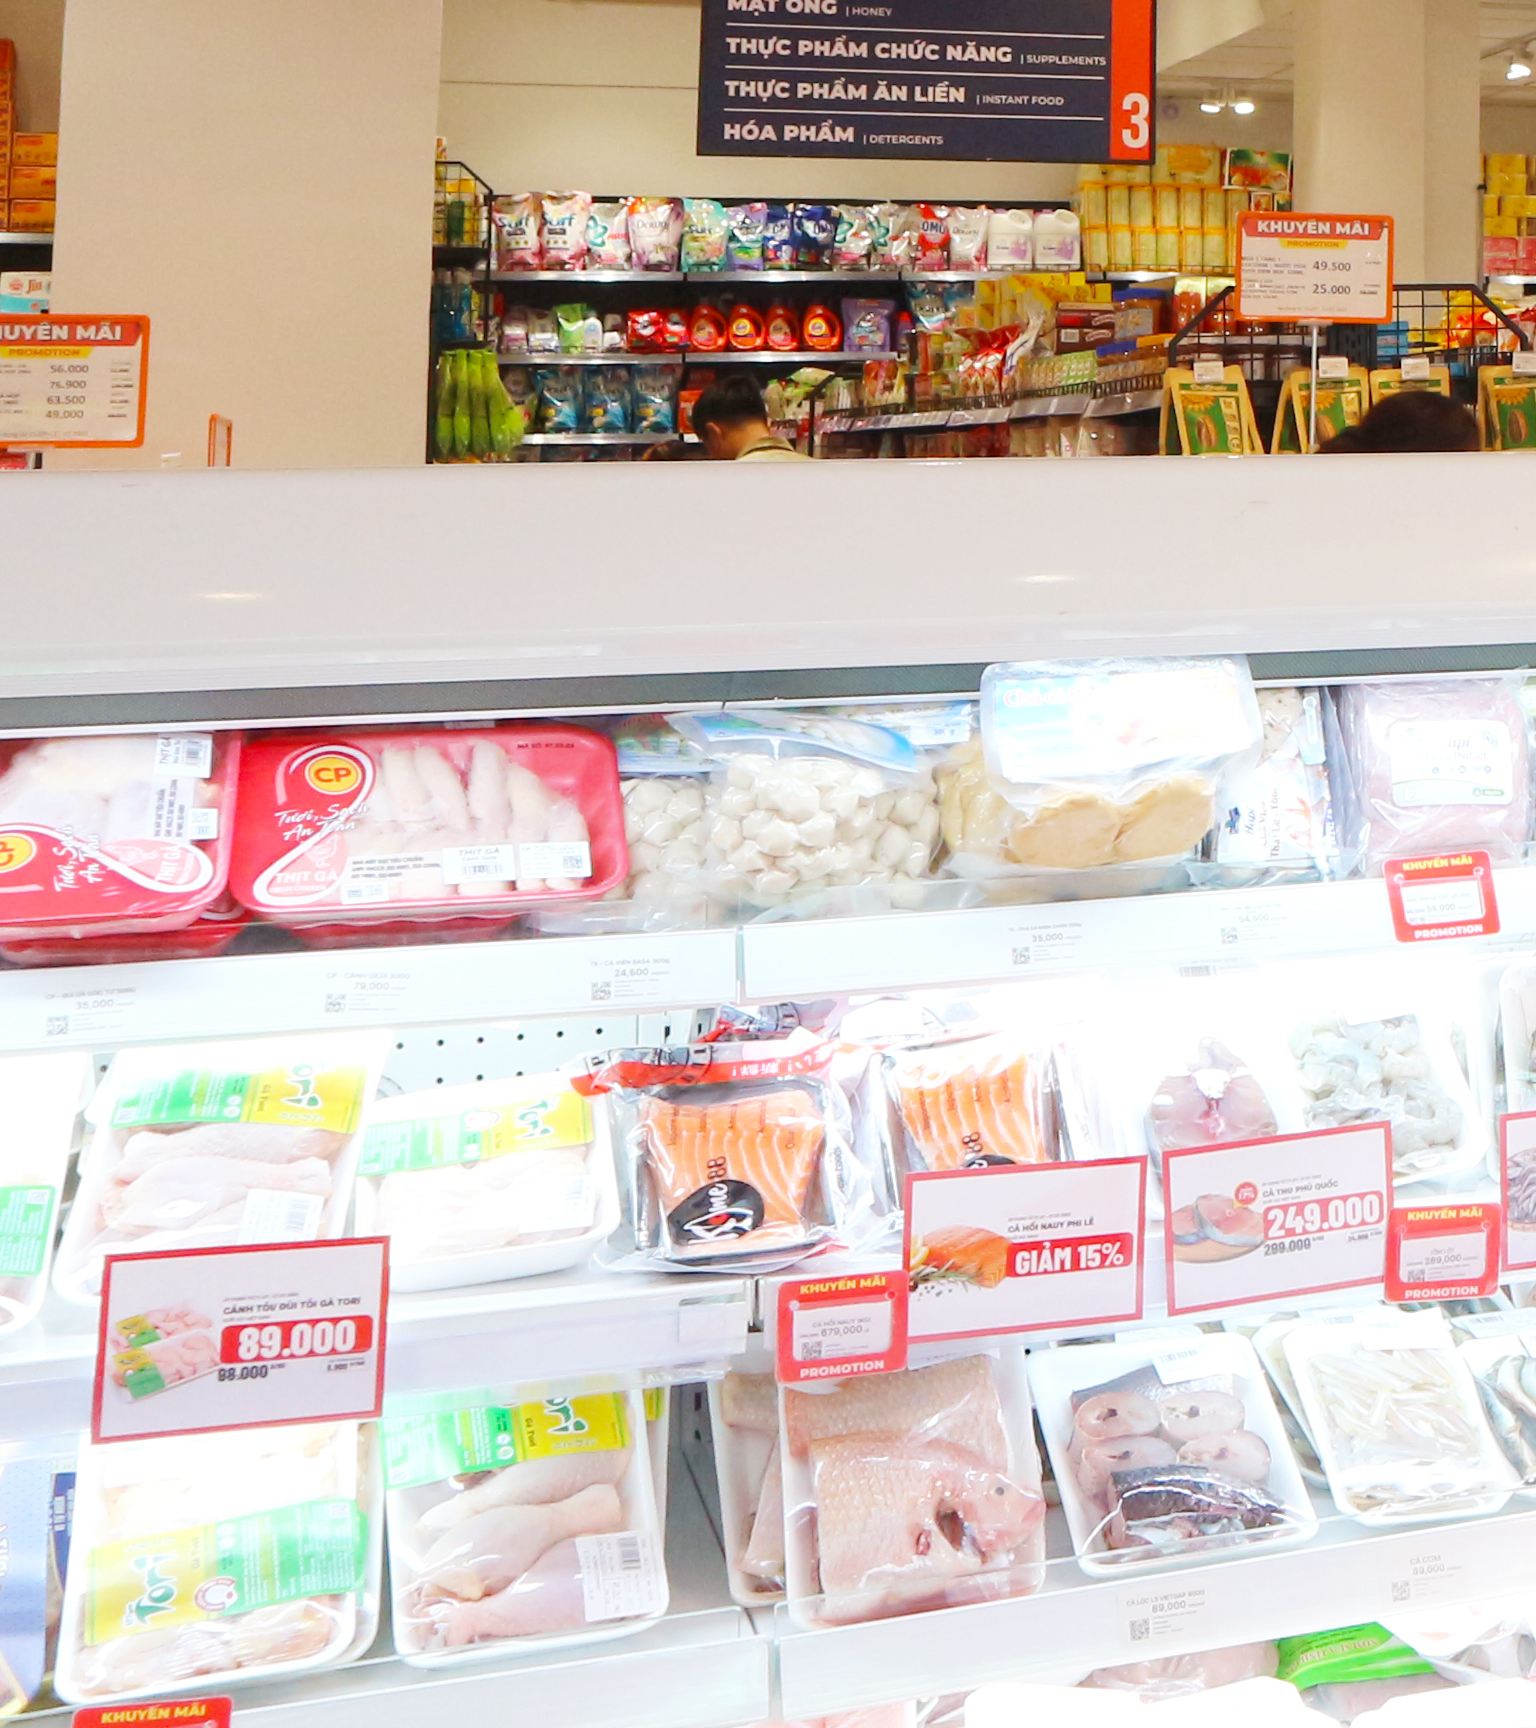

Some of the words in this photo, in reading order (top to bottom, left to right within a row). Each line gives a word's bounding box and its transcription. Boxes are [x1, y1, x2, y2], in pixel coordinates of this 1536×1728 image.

[852, 7, 892, 17] HONEY
[726, 36, 791, 59] THỰC
[798, 35, 868, 59] PHẨM
[874, 40, 938, 62] CHỨC
[946, 42, 1012, 64] NĂNG
[1027, 54, 1106, 66] SUPPLEMENTS
[725, 80, 790, 103] THỰC
[797, 77, 867, 103] PHẨM
[874, 80, 908, 103] ĂN
[914, 81, 966, 104] LIỀN
[982, 94, 1028, 105] INSTANT
[1031, 96, 1064, 106] FOOD
[1121, 92, 1149, 149] 3
[723, 121, 777, 142] HÓA
[784, 120, 854, 144] PHẨM
[869, 134, 944, 145] DETERGENTS
[1257, 219, 1331, 235] KHUYẾN
[1336, 220, 1370, 235] MÃI
[1313, 261, 1351, 272] 49.500
[1312, 284, 1351, 295] 25.000
[76, 322, 122, 341] MÃI
[314, 766, 350, 783] CP
[1414, 924, 1483, 939] PROMOTION
[1267, 1193, 1380, 1238] 249.000
[1407, 1208, 1456, 1221] KHUYẾN
[1459, 1206, 1483, 1219] MÃI
[1015, 1240, 1072, 1275] GIẢM
[1077, 1241, 1124, 1270] 15%
[800, 1278, 858, 1294] KHUYẾN
[860, 1275, 886, 1290] MÃI
[1405, 1286, 1479, 1299] PROMOTION
[238, 1319, 357, 1361] 89.000
[800, 1360, 884, 1379] PROMOTION
[101, 1704, 170, 1726] KHUYẾN
[174, 1701, 207, 1720] MÃI
